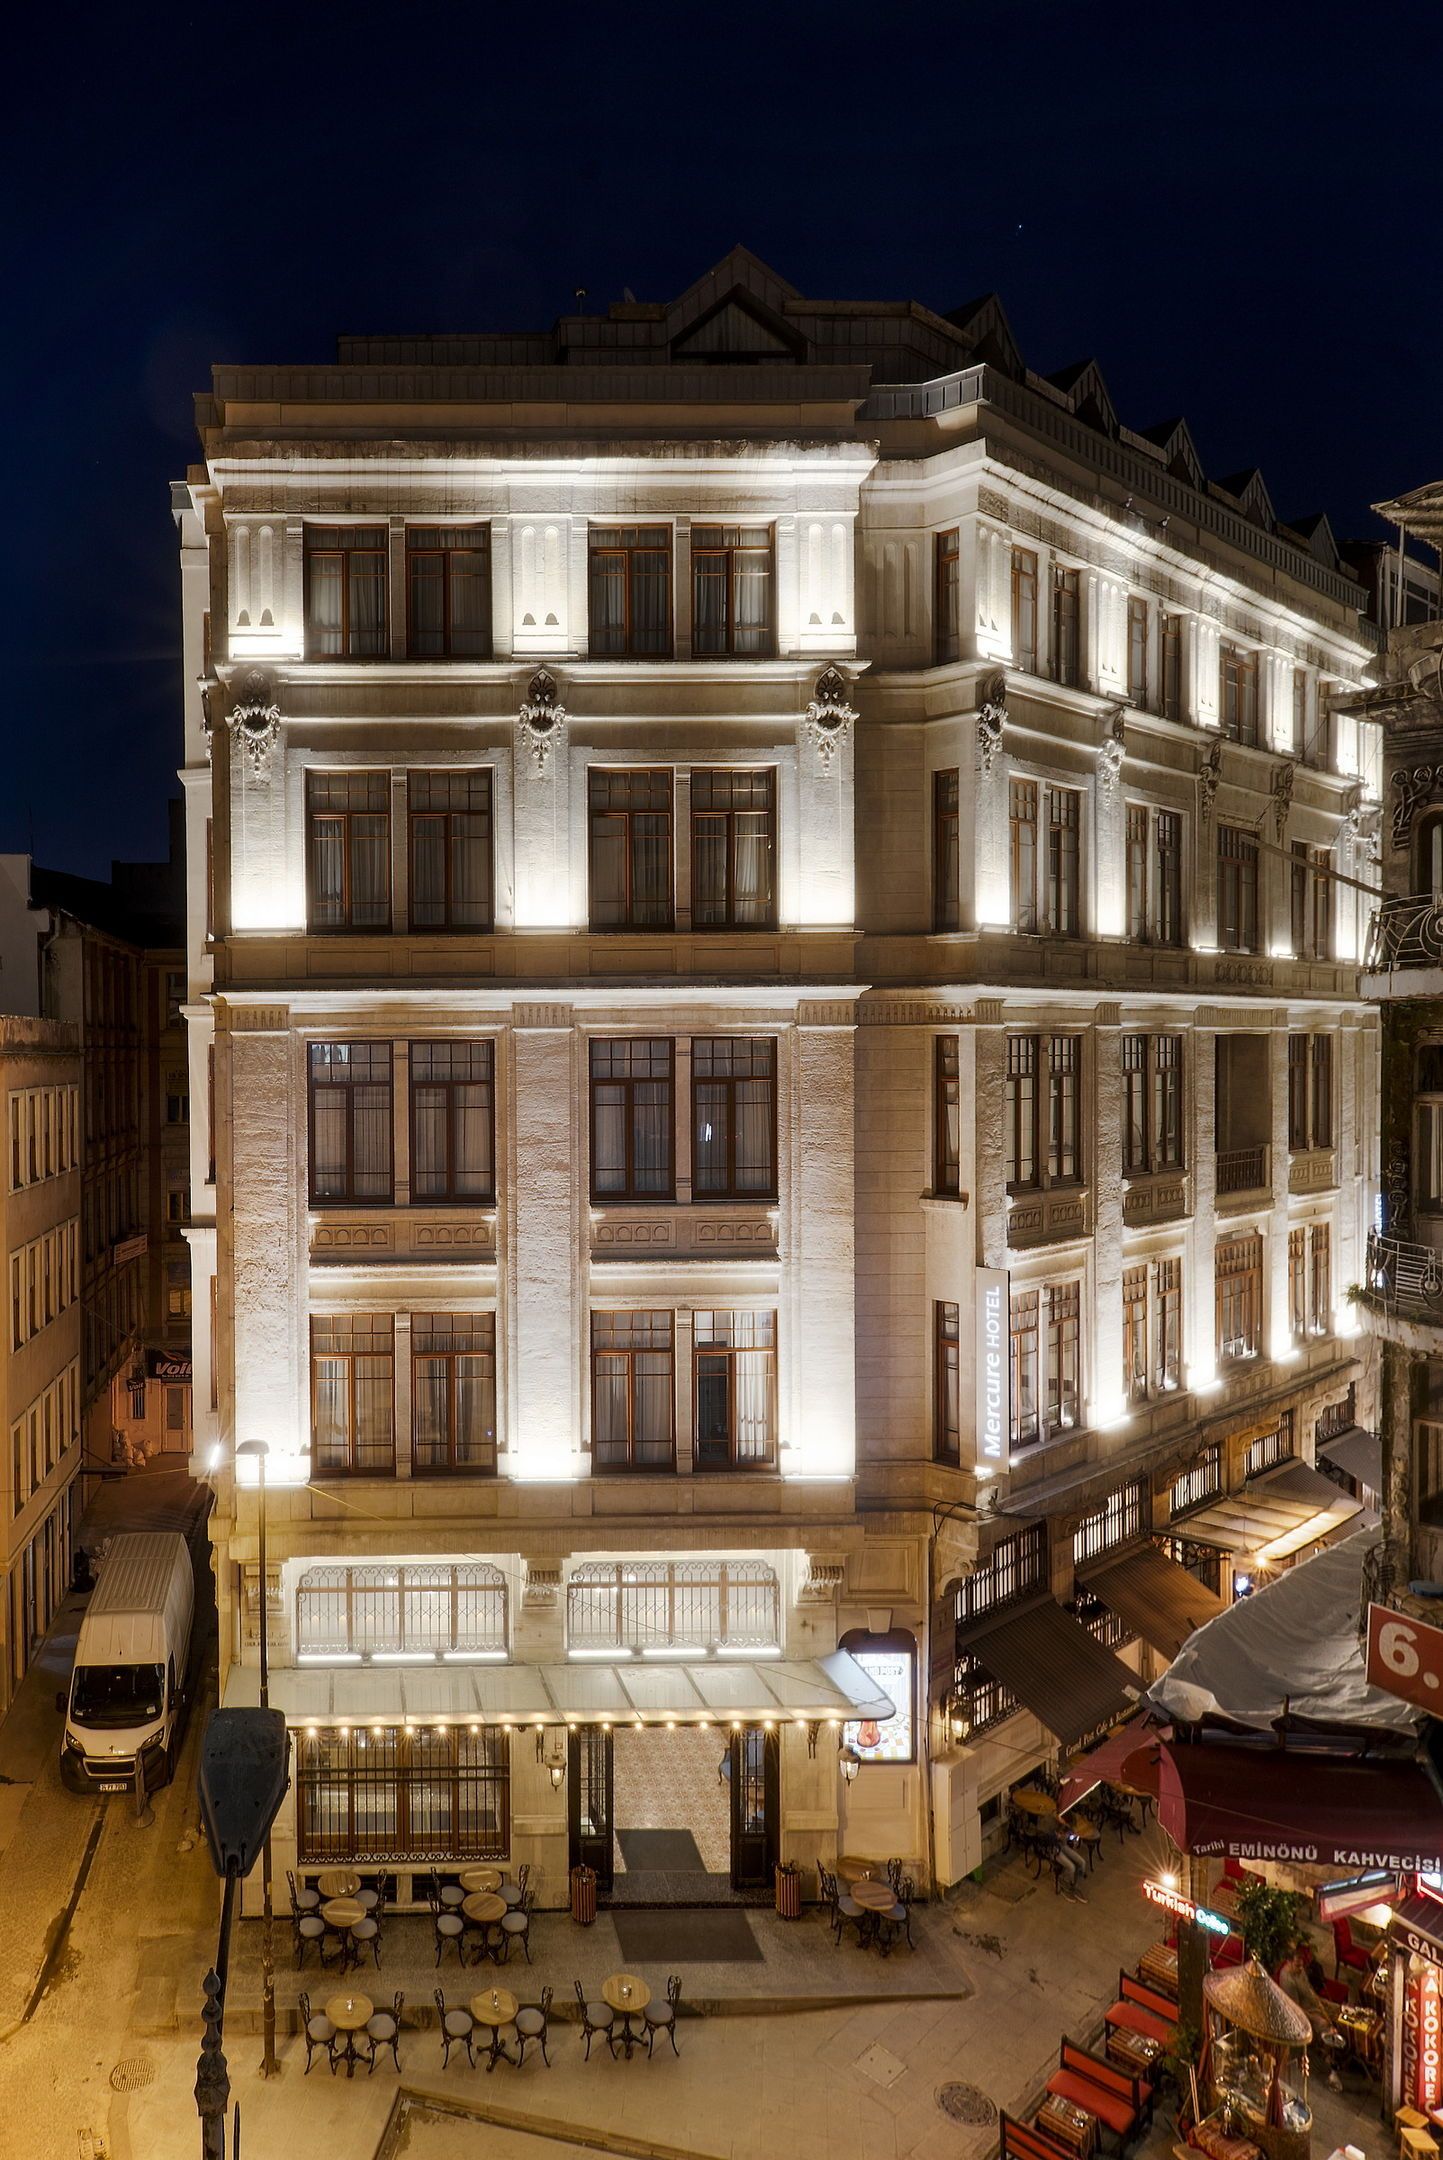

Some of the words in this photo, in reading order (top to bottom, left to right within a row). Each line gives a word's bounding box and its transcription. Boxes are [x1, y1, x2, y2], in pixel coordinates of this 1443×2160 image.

[986, 1286, 1000, 1348] HOTEL
[984, 1352, 1001, 1457] Mercure
[1193, 1839, 1225, 1855] Tarihi
[1229, 1841, 1318, 1861] EMİNÖNÜ
[1143, 1882, 1195, 1920] Turkish
[1407, 1933, 1443, 1965] GAL
